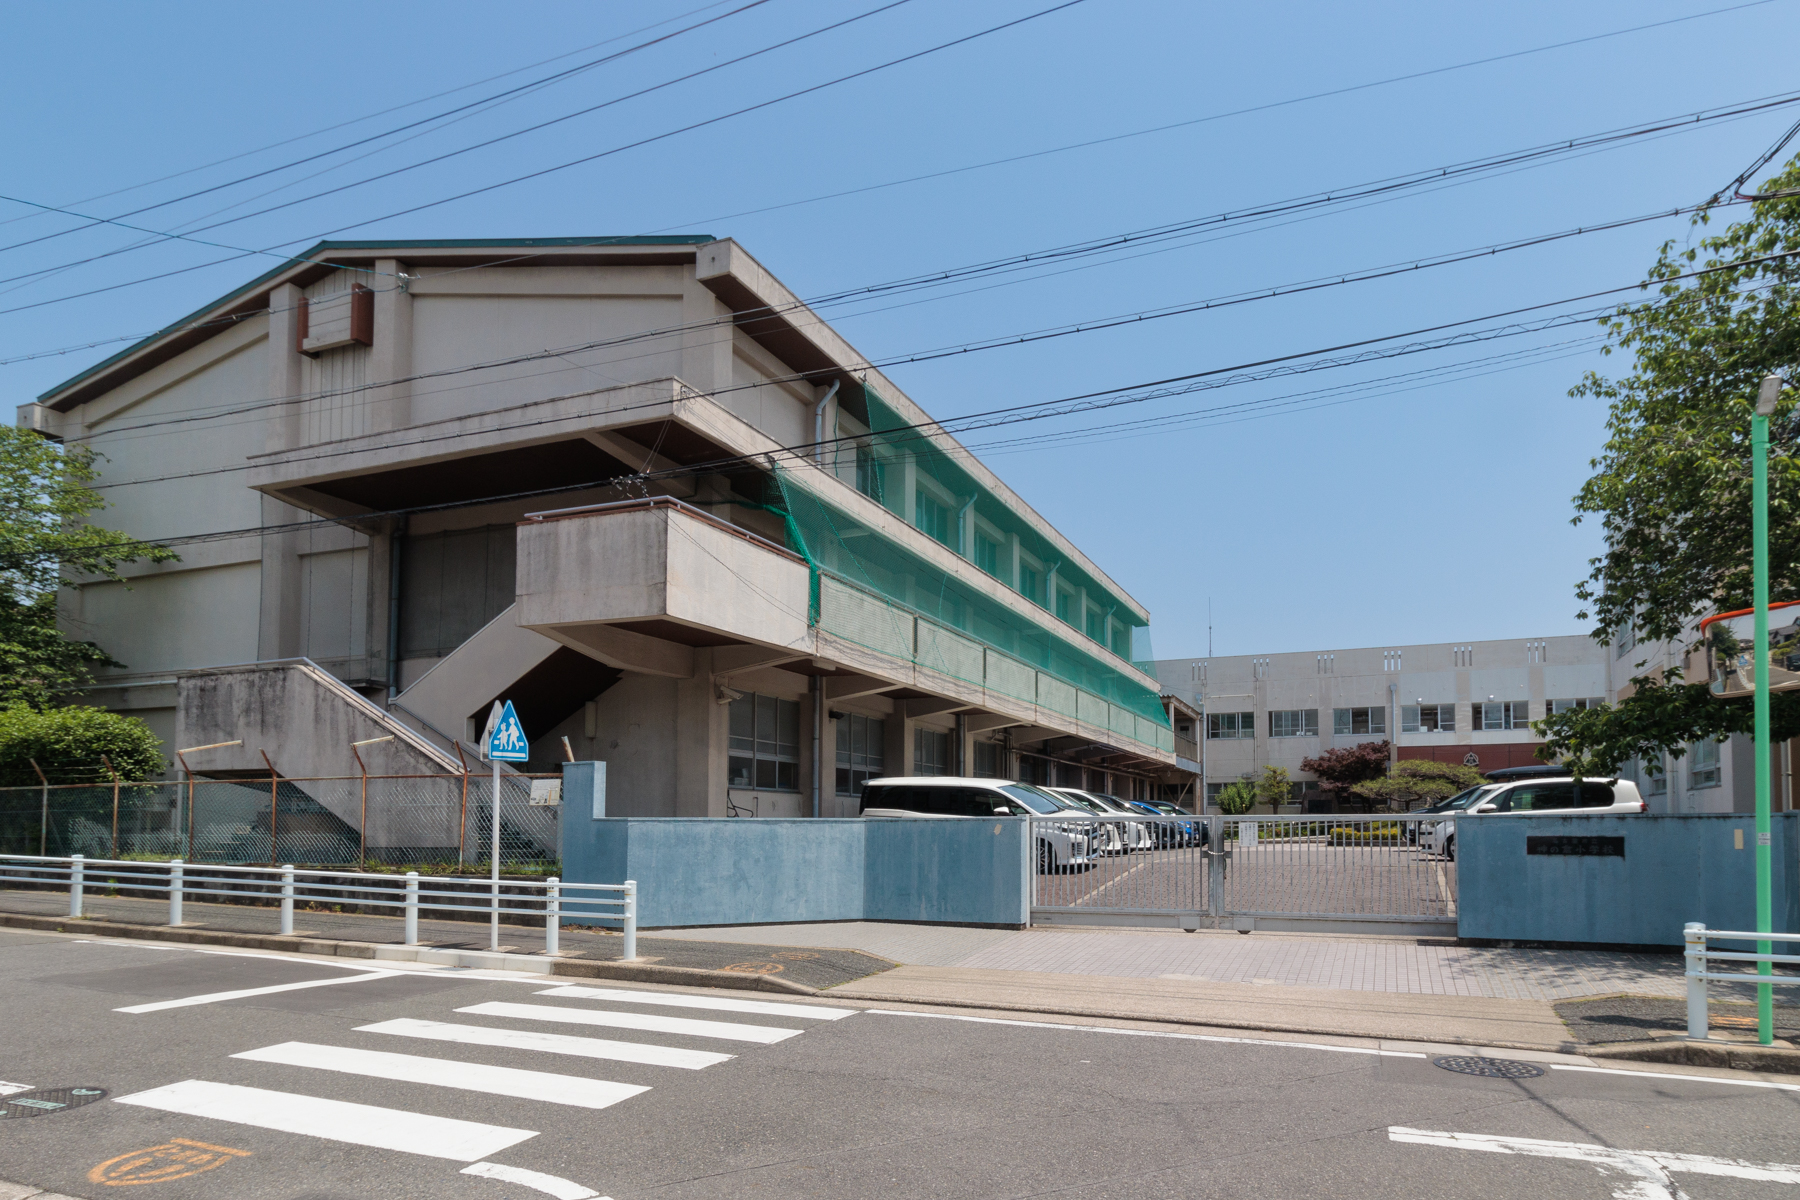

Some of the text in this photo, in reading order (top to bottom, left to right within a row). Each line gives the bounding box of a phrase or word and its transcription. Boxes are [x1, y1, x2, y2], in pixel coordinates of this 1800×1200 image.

[1536, 844, 1615, 854] 神の倉小学校
